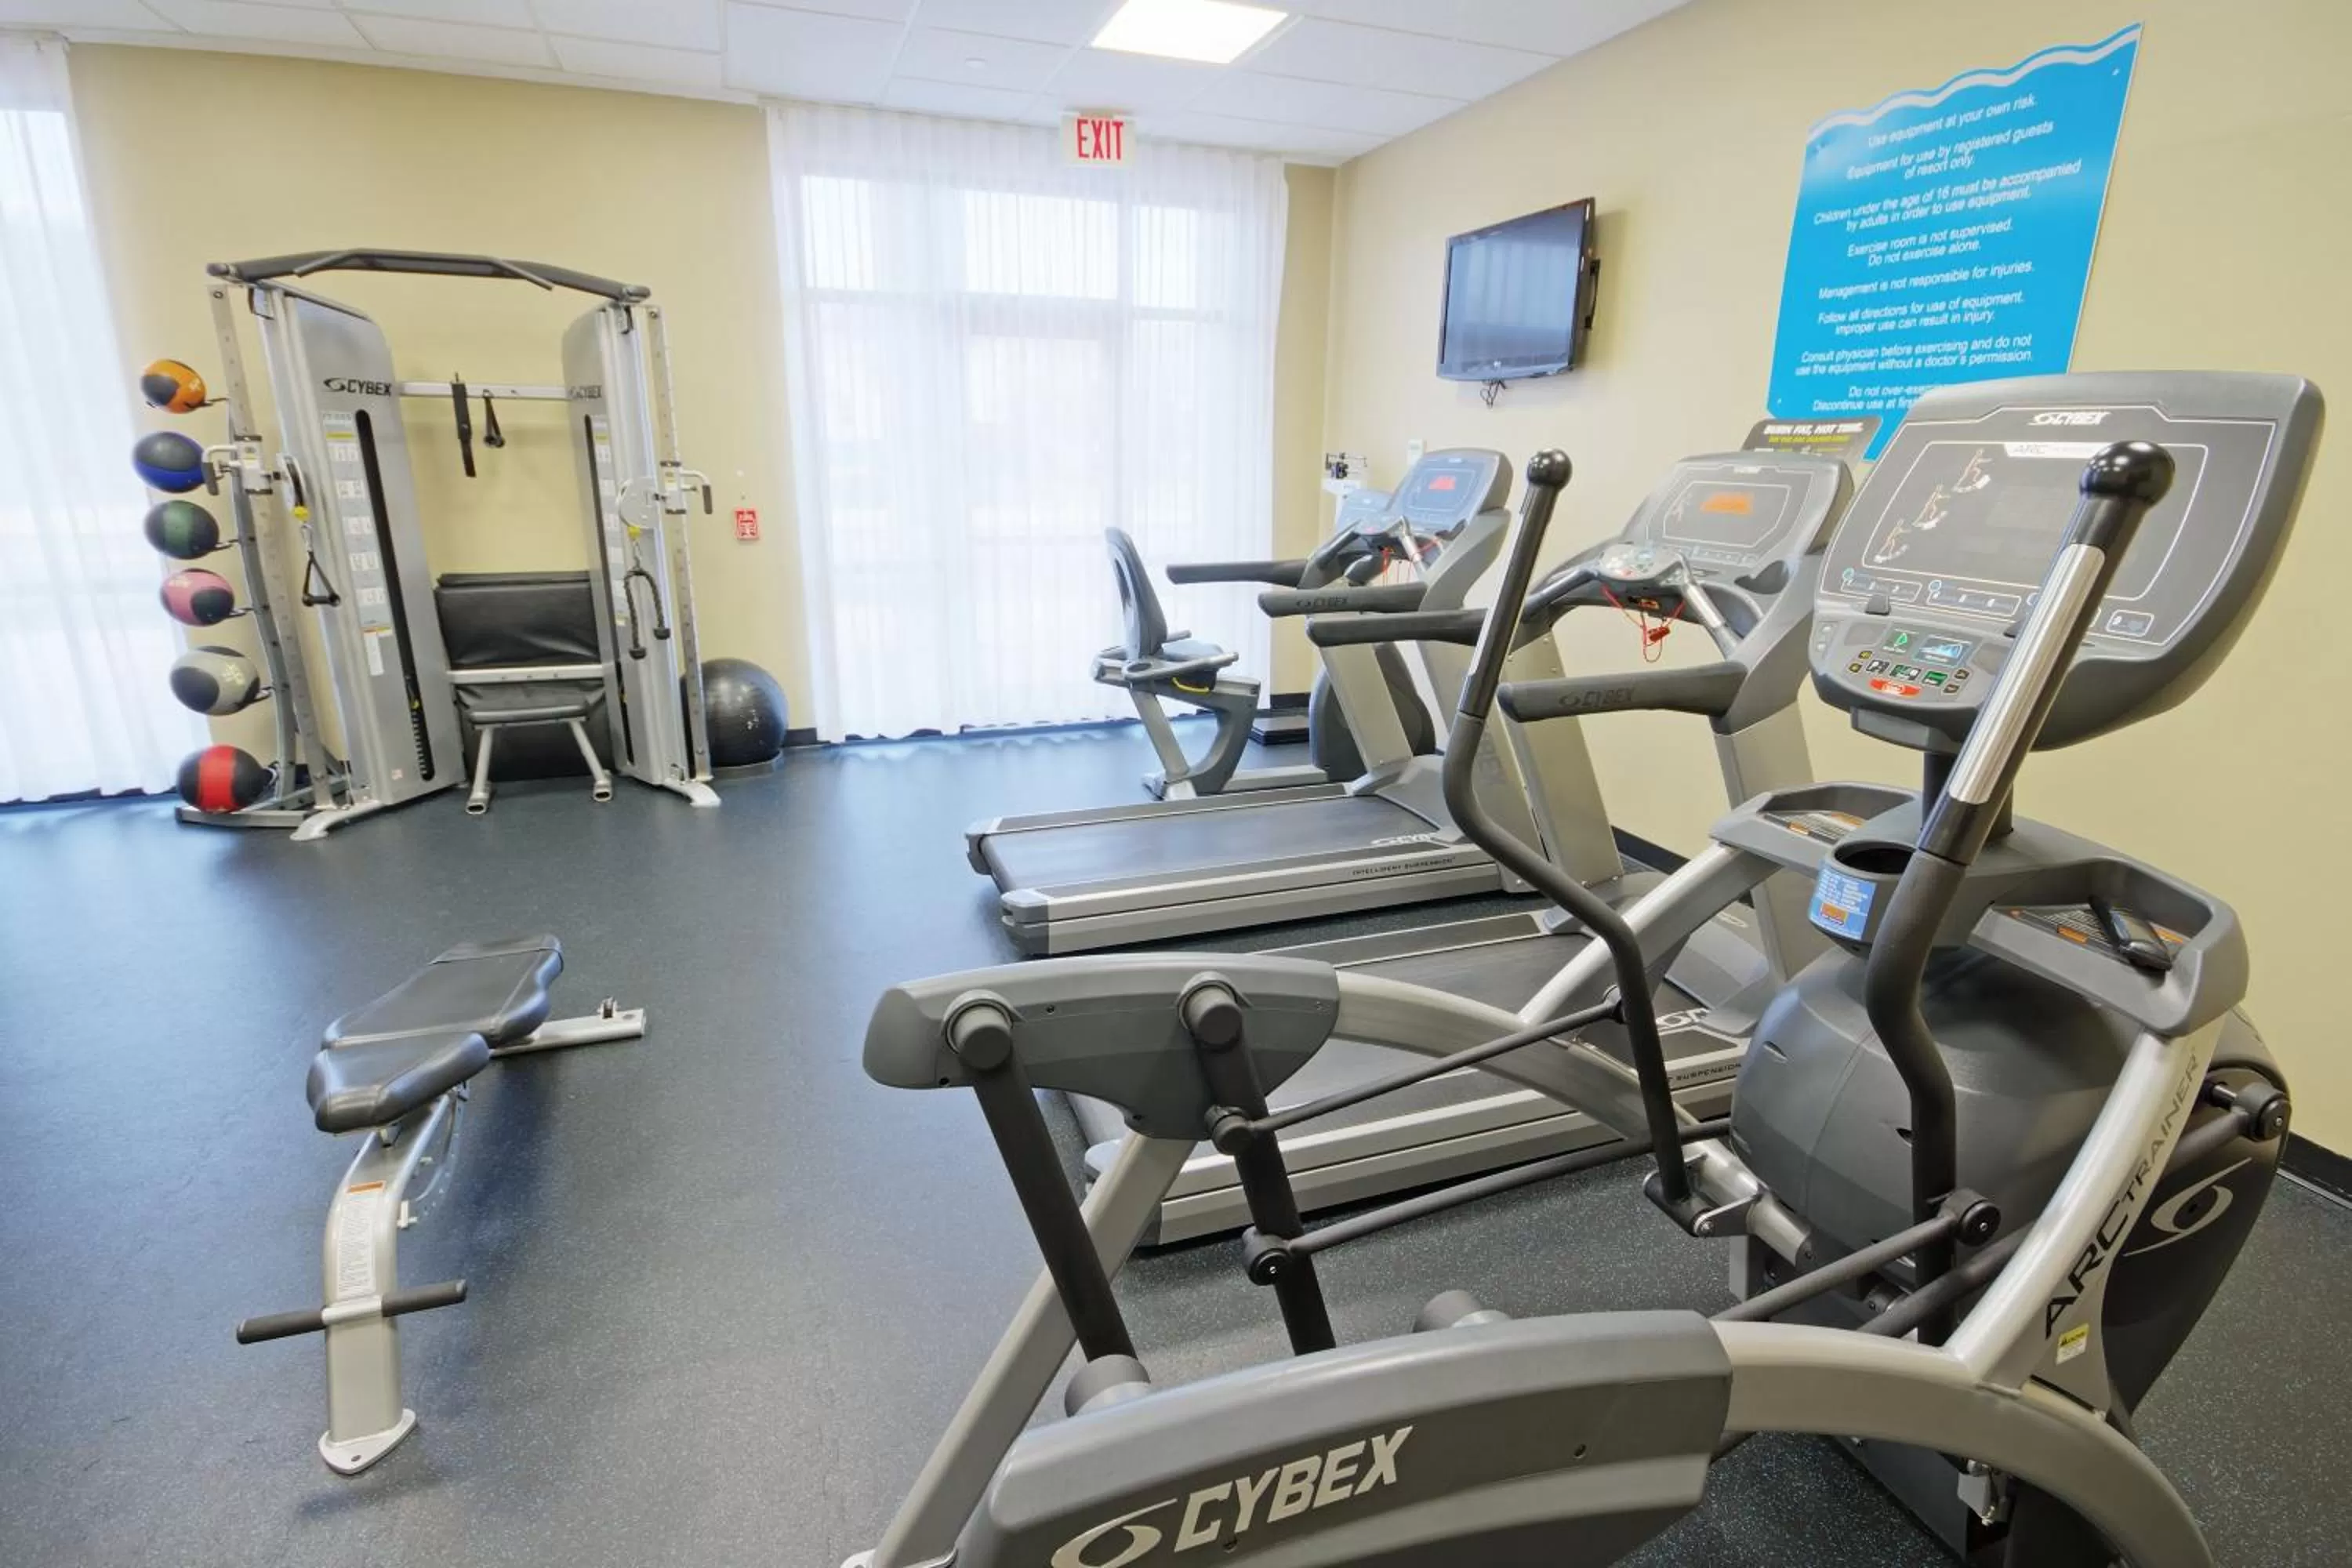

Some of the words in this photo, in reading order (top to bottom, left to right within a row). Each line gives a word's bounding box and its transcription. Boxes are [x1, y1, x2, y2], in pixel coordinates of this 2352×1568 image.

[1077, 118, 1123, 160] EXIT
[1868, 136, 1887, 148] Use
[1889, 120, 1944, 143] equipment
[1944, 115, 1958, 129] at
[1958, 110, 1984, 127] your
[1985, 105, 2010, 118] own
[1846, 155, 1898, 180] Equipment
[1900, 151, 1915, 167] for
[1916, 149, 1936, 163] use
[1936, 143, 1951, 161] by
[1953, 131, 2012, 155] registered
[2012, 122, 2054, 143] guests
[1903, 165, 1918, 180] of
[1917, 158, 1949, 177] resort
[1949, 153, 1975, 171] only.
[1813, 204, 1852, 226] Children
[1852, 198, 1882, 219] under
[1882, 195, 1899, 211] the
[1899, 193, 1920, 212] age
[1921, 188, 1936, 204] of
[1936, 187, 1951, 200] 16
[1951, 180, 1980, 198] must
[1981, 176, 1997, 191] be
[1998, 160, 2082, 189] accompanied
[1846, 218, 1857, 232] by
[1858, 214, 1889, 230] adults
[1889, 211, 1900, 223] in
[1901, 205, 1930, 222] order
[1930, 202, 1944, 216] to
[1944, 200, 1965, 213] use
[1966, 187, 2032, 210] equipment.
[1847, 242, 1889, 258] Exercise
[1889, 238, 1918, 250] room
[1918, 236, 1929, 246] is
[1929, 230, 1948, 243] not
[1948, 219, 2013, 242] supervised.
[1867, 254, 1882, 267] Do
[1883, 252, 1900, 264] not
[1901, 244, 1947, 262] exercise
[1947, 240, 1982, 256] alone.
[1818, 282, 1879, 301] Management
[1879, 281, 1889, 292] is
[1889, 278, 1907, 290] not
[1908, 268, 1970, 289] responsible
[1971, 266, 1988, 279] for
[1817, 313, 1846, 325] Follow
[1847, 310, 1860, 322] all
[1860, 307, 1908, 321] directions
[1910, 303, 1925, 315] for
[1926, 301, 1947, 313] use
[1947, 298, 1961, 310] of
[1962, 292, 2024, 312] equipment.
[1878, 320, 1896, 332] use
[1897, 318, 1918, 329] can
[1918, 314, 1949, 328] result
[1950, 313, 1962, 324] in
[1962, 310, 1995, 327] injury.
[1795, 367, 1812, 376] use
[1812, 365, 1827, 375] the
[1827, 361, 1878, 376] equipment
[1877, 358, 1914, 371] without
[1914, 359, 1922, 368] a
[1968, 350, 2033, 366] permission.
[1801, 351, 1835, 364] Consult
[1835, 349, 1879, 364] physician
[1880, 344, 1913, 358] before
[1914, 339, 1970, 357] exercising
[1970, 336, 1993, 350] and
[1994, 336, 2011, 348] do
[2012, 335, 2033, 347] not
[347, 378, 393, 397] CYBEX
[1848, 386, 1863, 398] Do
[1864, 385, 1880, 397] not
[1812, 397, 1864, 412] Discontinue
[1865, 397, 1884, 410] use
[1885, 397, 1896, 409] at
[1676, 1062, 1742, 1081] SUSPENSION
[1174, 1425, 1414, 1552] CYBEX
